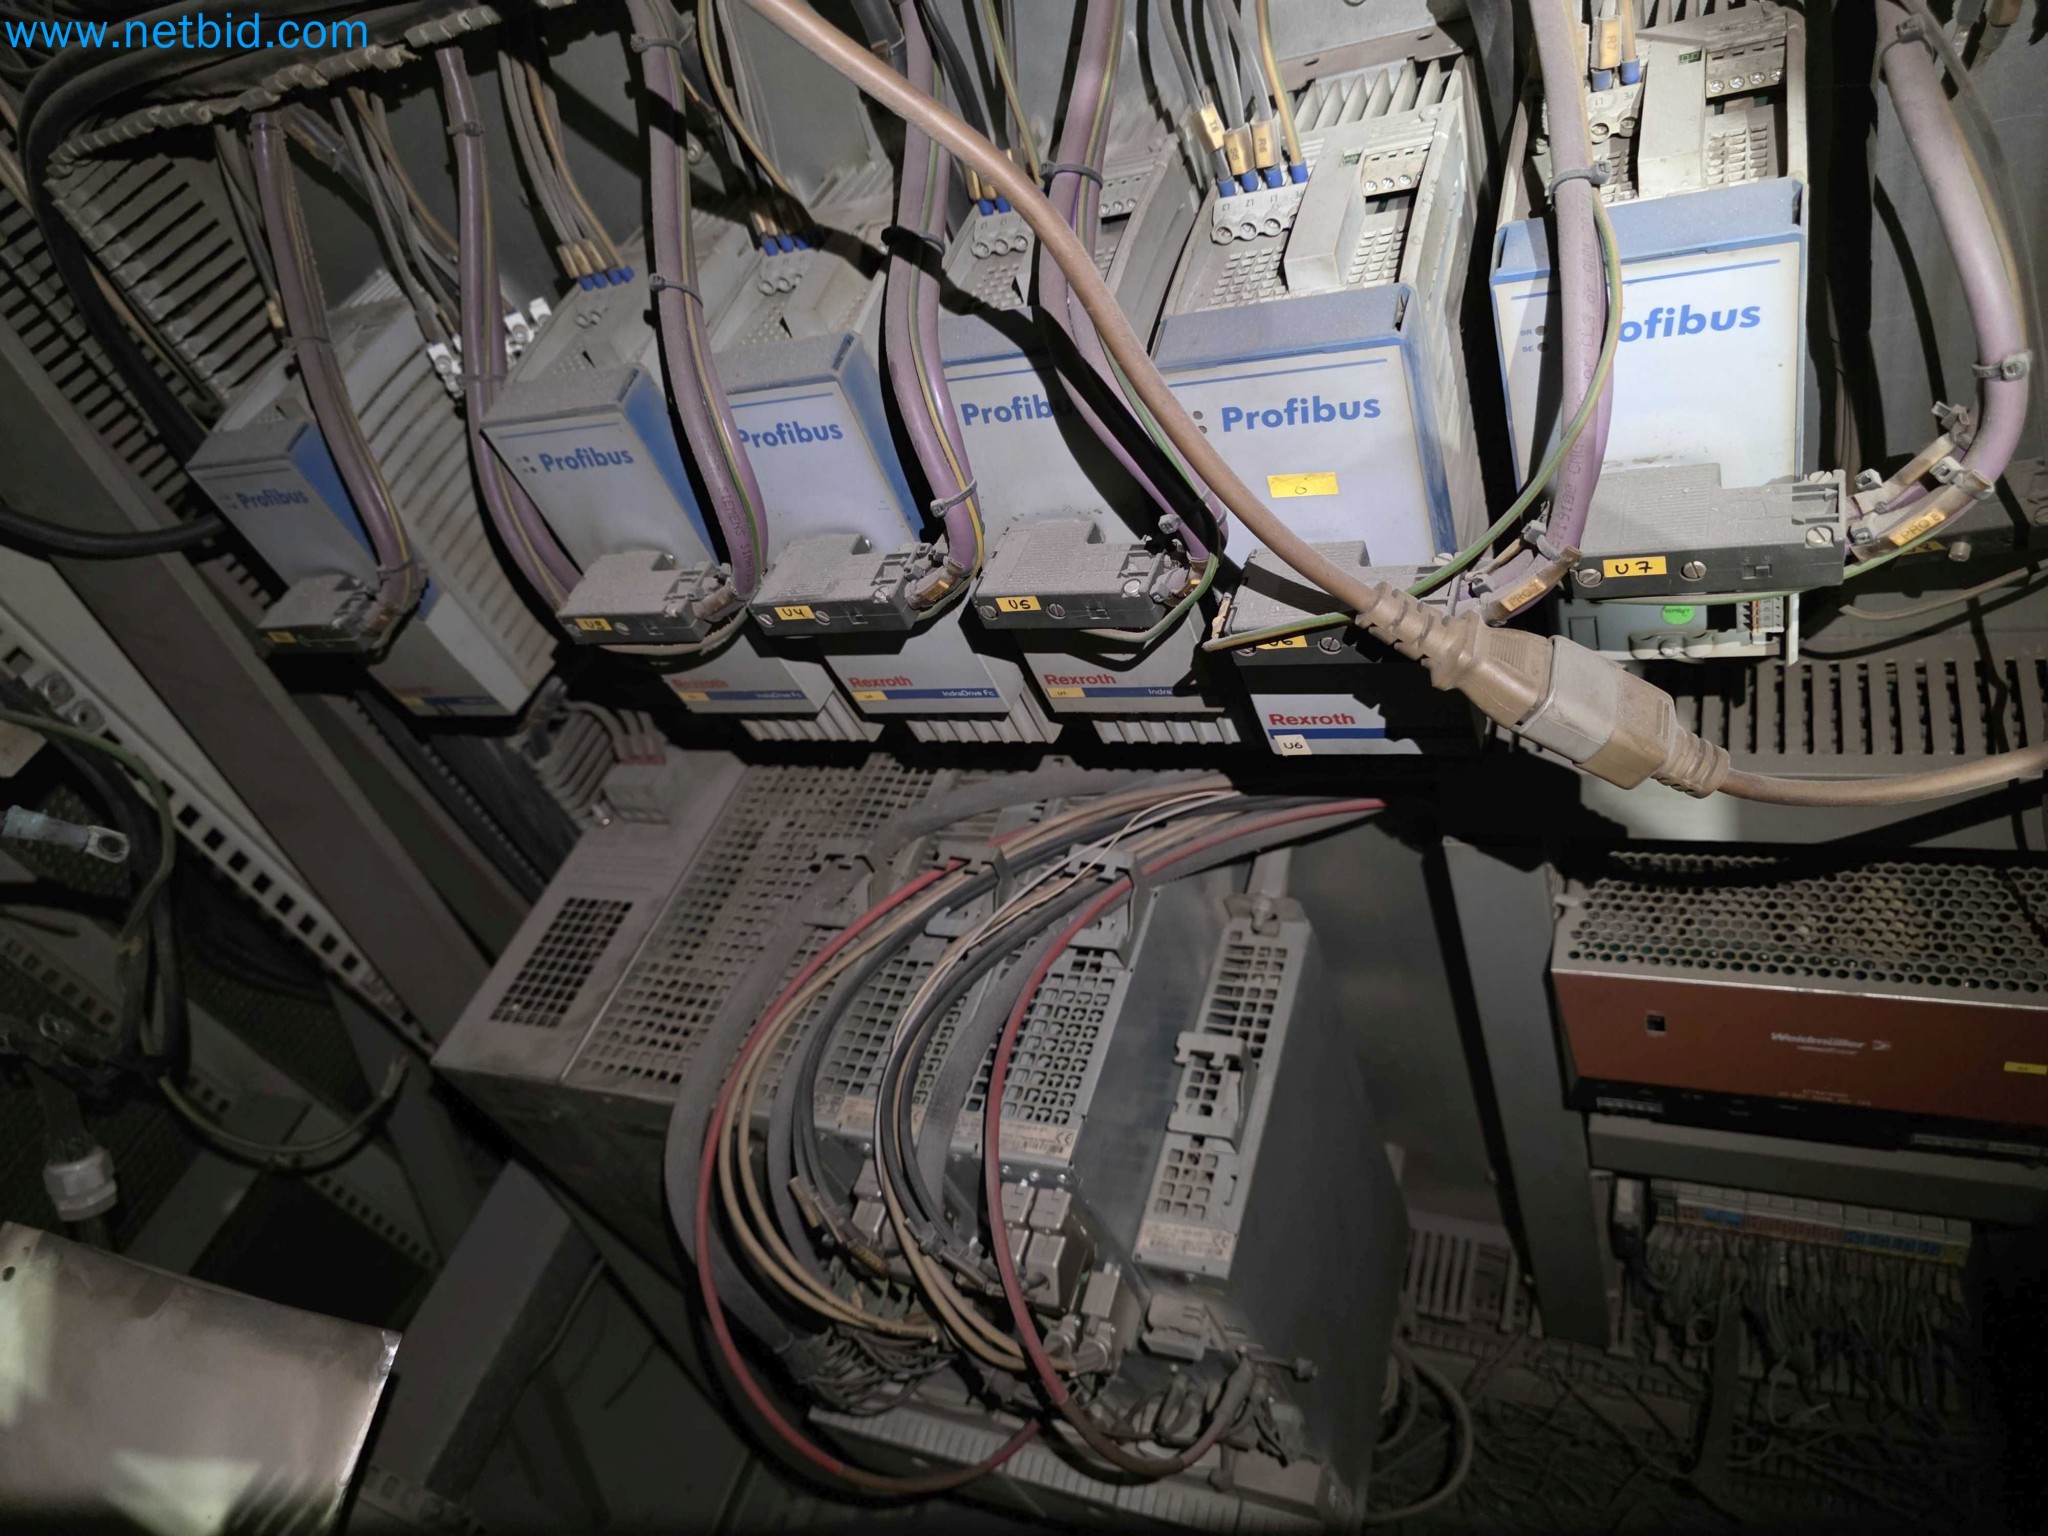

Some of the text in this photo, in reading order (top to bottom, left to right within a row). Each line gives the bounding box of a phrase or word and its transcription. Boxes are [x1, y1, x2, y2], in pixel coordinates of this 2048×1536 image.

[1617, 303, 1761, 342] ofibus
[960, 394, 1054, 426] Profib
[1221, 395, 1381, 432] Profibus
[538, 446, 634, 473] Profibus
[235, 488, 310, 509] Profibus
[849, 675, 913, 688] Rexroth
[1044, 674, 1117, 686] Rexroth
[942, 690, 982, 698] IndraDrive
[1268, 713, 1356, 726] Rexroth
[1283, 741, 1303, 750] U6
